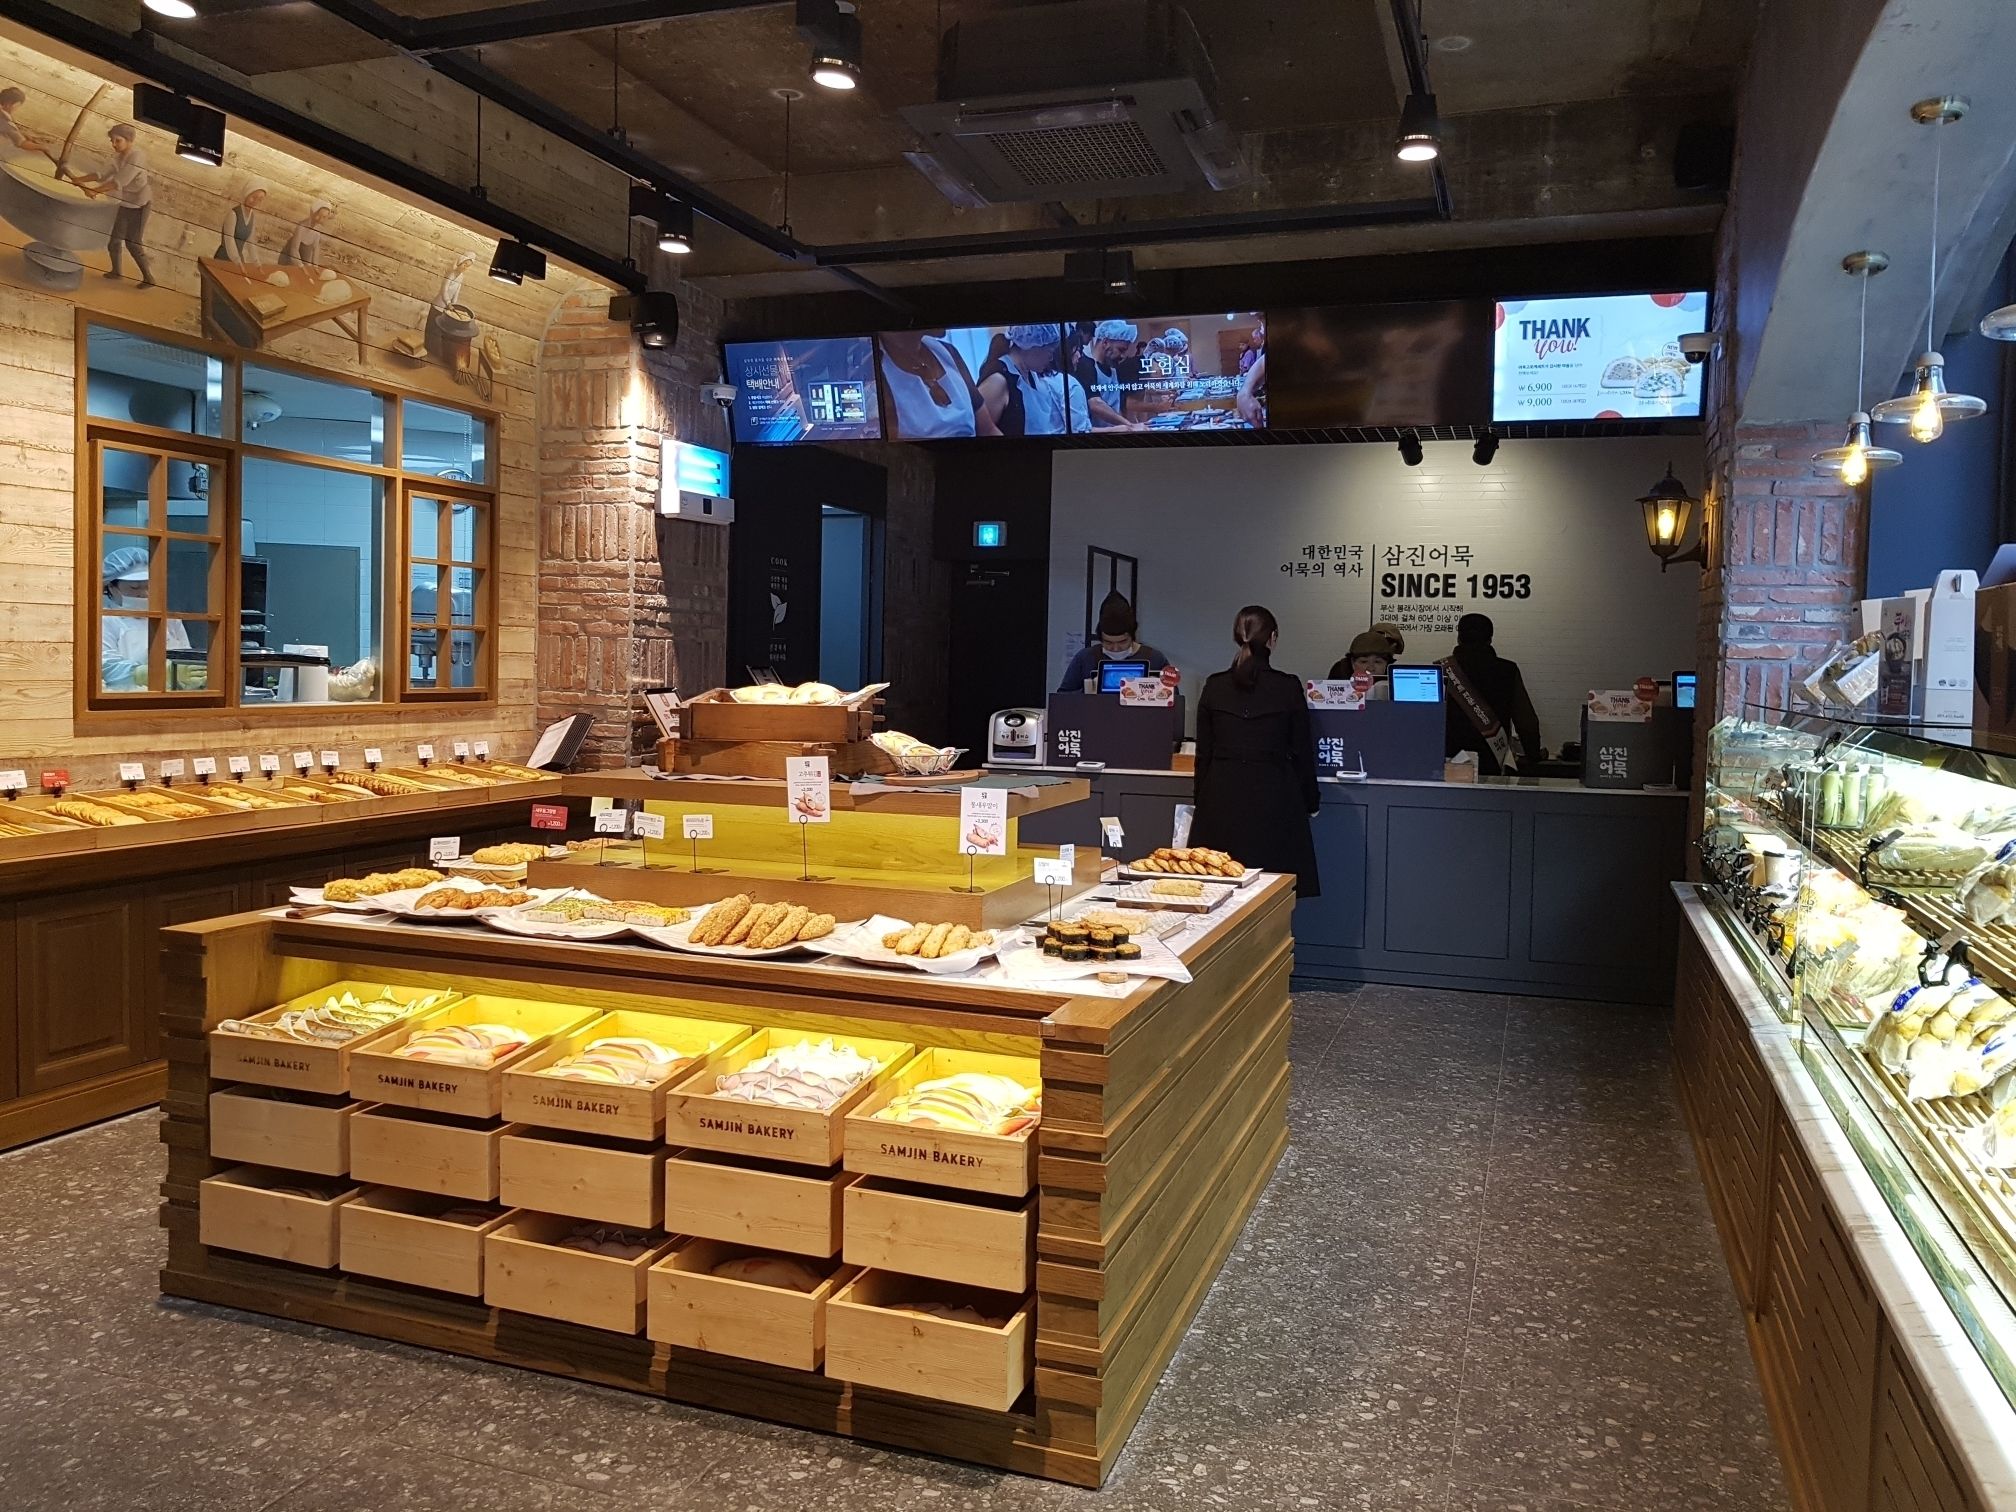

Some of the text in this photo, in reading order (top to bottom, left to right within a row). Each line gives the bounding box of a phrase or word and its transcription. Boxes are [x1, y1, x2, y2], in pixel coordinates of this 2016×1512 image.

[1519, 318, 1590, 340] THANK
[1534, 333, 1579, 360] you!
[1139, 354, 1190, 375] 모험심
[746, 378, 780, 390] 택배안내
[1144, 382, 1161, 390] 어묵의
[1528, 383, 1552, 392] 6,900
[1527, 398, 1552, 407] 9,000
[1302, 544, 1364, 560] 대한민국
[1381, 544, 1474, 568] 삼진어묵
[1280, 562, 1364, 578] 어묵의 역사
[1381, 573, 1531, 599] SINCE 1953
[1380, 604, 1464, 613] 부산 봉래시장에서 시작해
[1401, 614, 1416, 622] 걸쳐
[1418, 614, 1434, 622] 60년
[1437, 614, 1451, 623] 이상
[1420, 624, 1432, 632] 가장
[1434, 624, 1454, 632] 오래된
[1058, 729, 1081, 742] 삼진
[1318, 737, 1344, 750] 삼진
[1058, 742, 1081, 758] 어묵
[1599, 747, 1627, 760] 삼진
[1318, 750, 1344, 767] 어묵
[1599, 760, 1627, 778] 어묵
[273, 1058, 311, 1072] BAKERY
[378, 1074, 459, 1095] SAMJIN BAKERY
[532, 1095, 620, 1115] SAMJIN BAKERY
[700, 1118, 795, 1141] SAMJIN BAKERY
[880, 1143, 984, 1169] SAMJIN BAKERY
